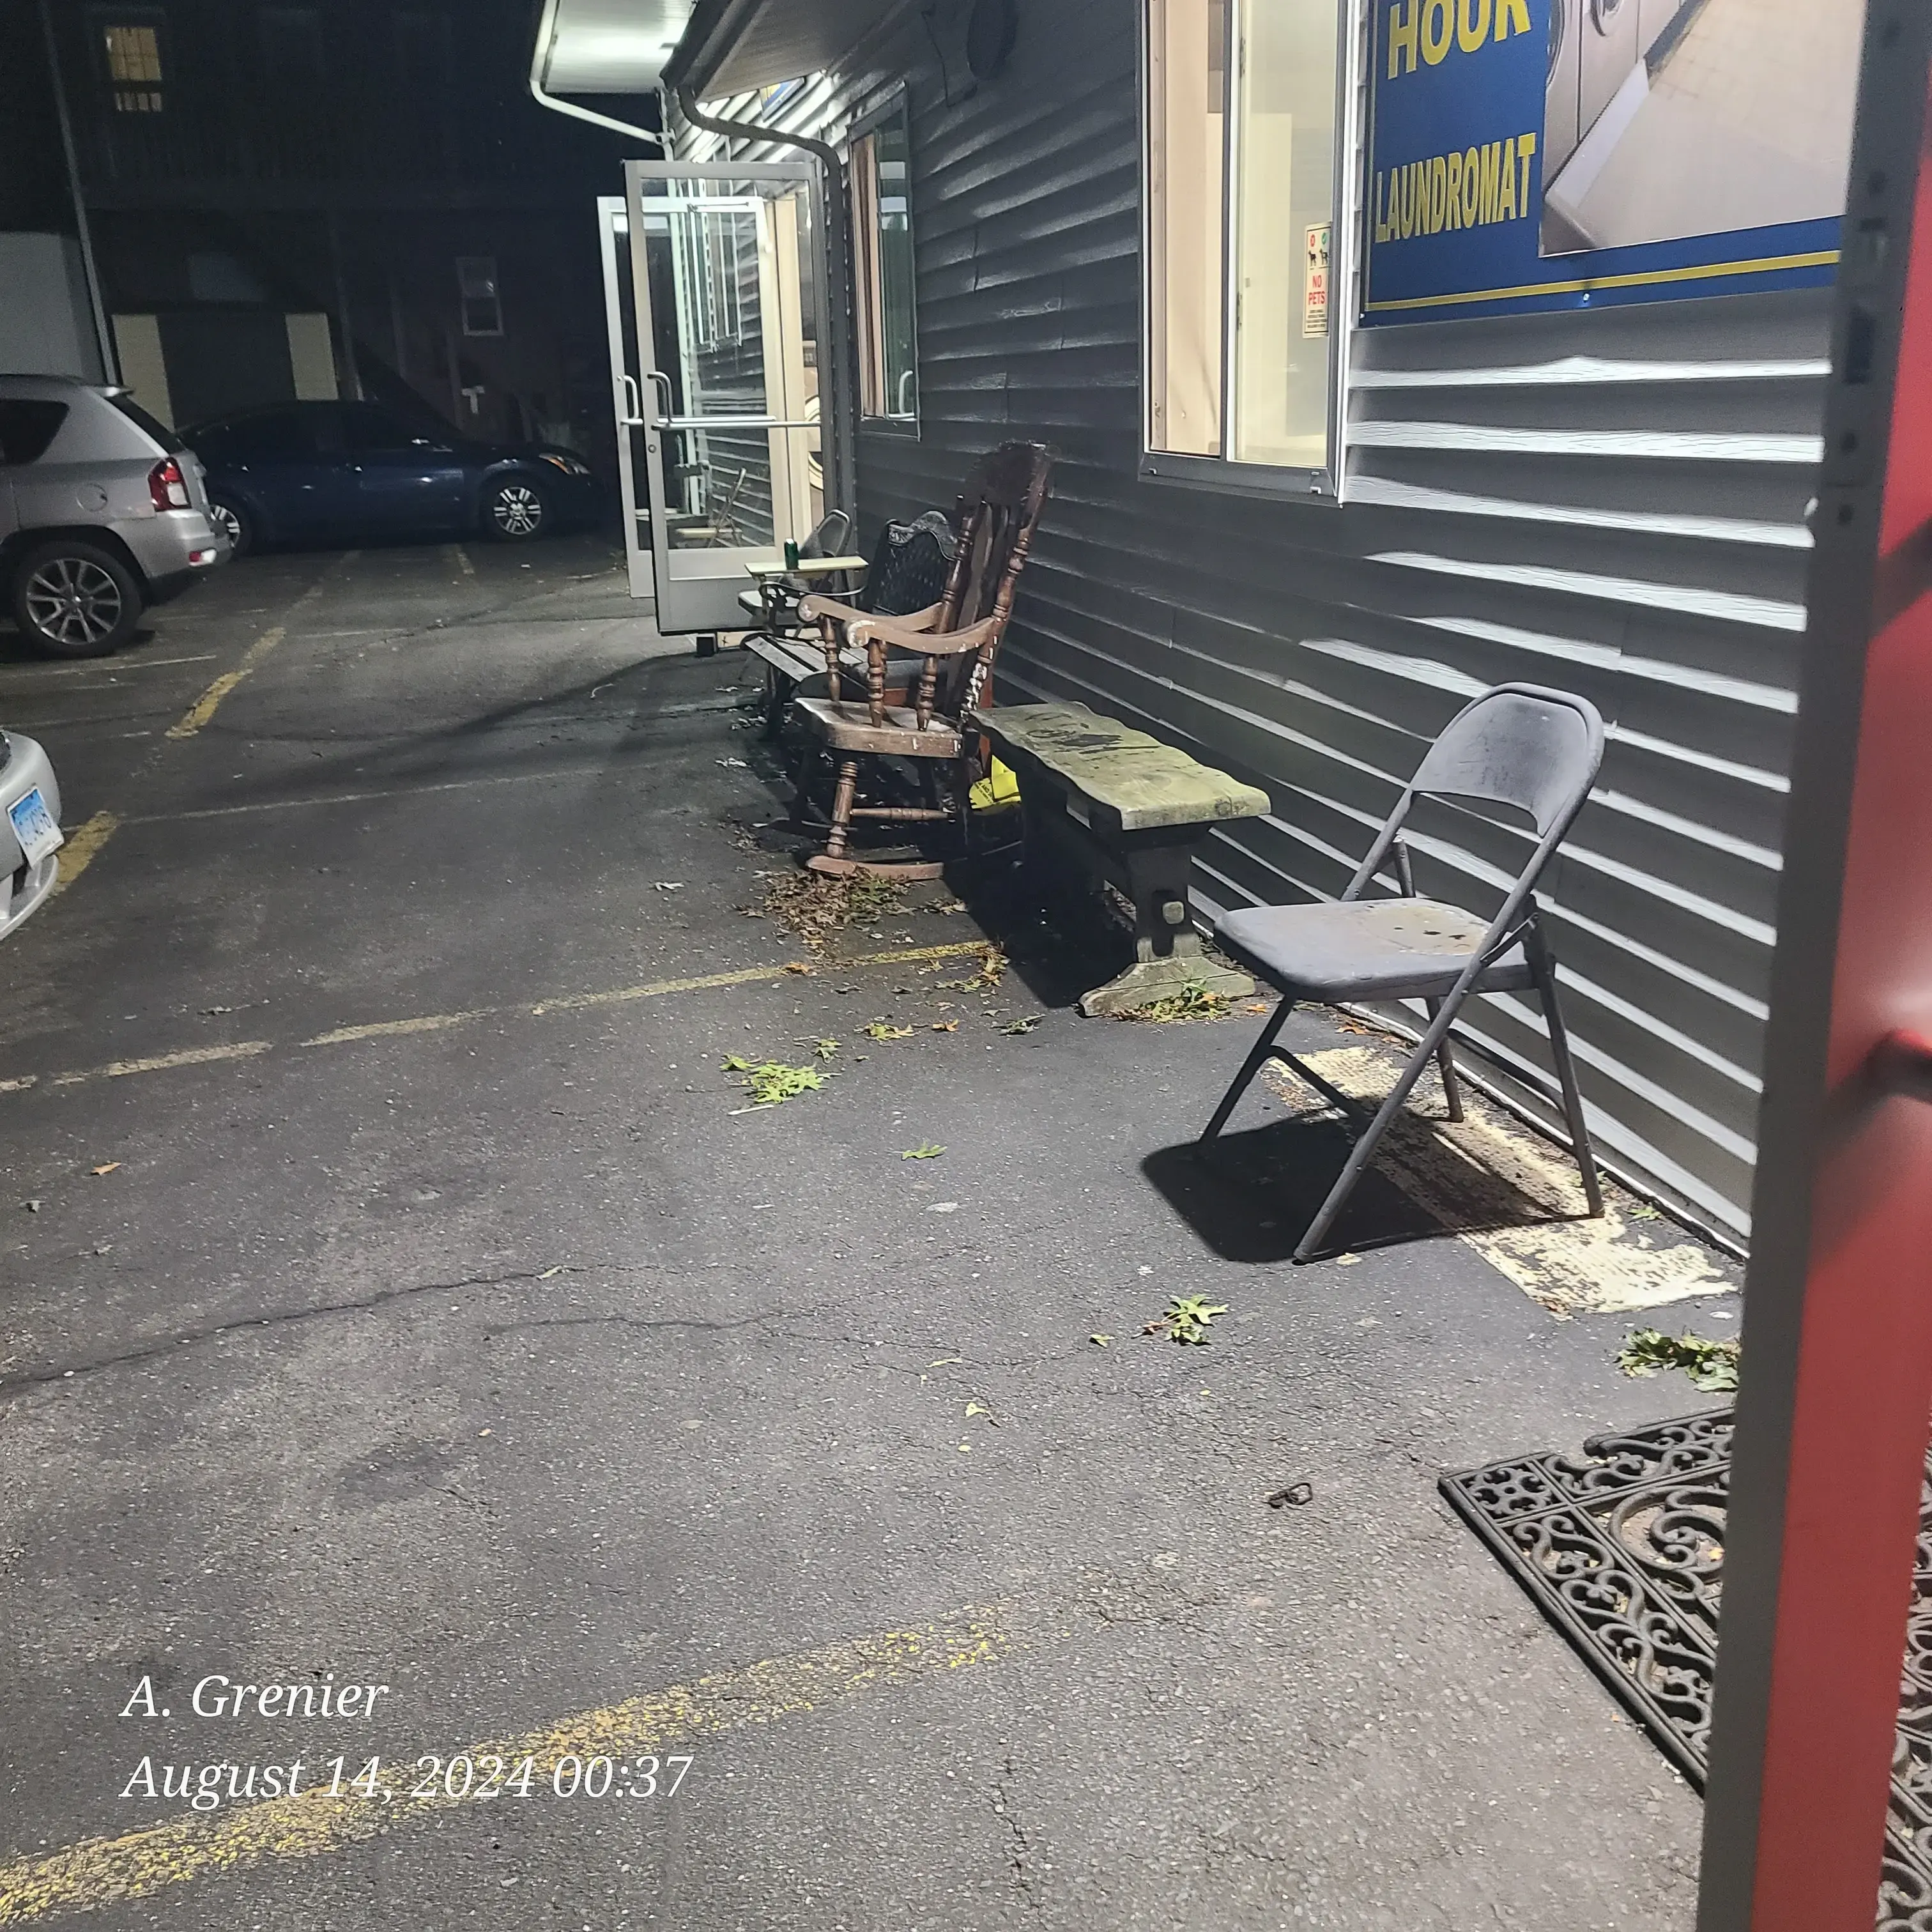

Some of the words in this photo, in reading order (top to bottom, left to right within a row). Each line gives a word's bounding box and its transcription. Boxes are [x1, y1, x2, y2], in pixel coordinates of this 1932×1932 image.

[1374, 132, 1537, 243] LAUNDROMAT
[1312, 275, 1322, 288] NO
[1308, 291, 1325, 305] PETS
